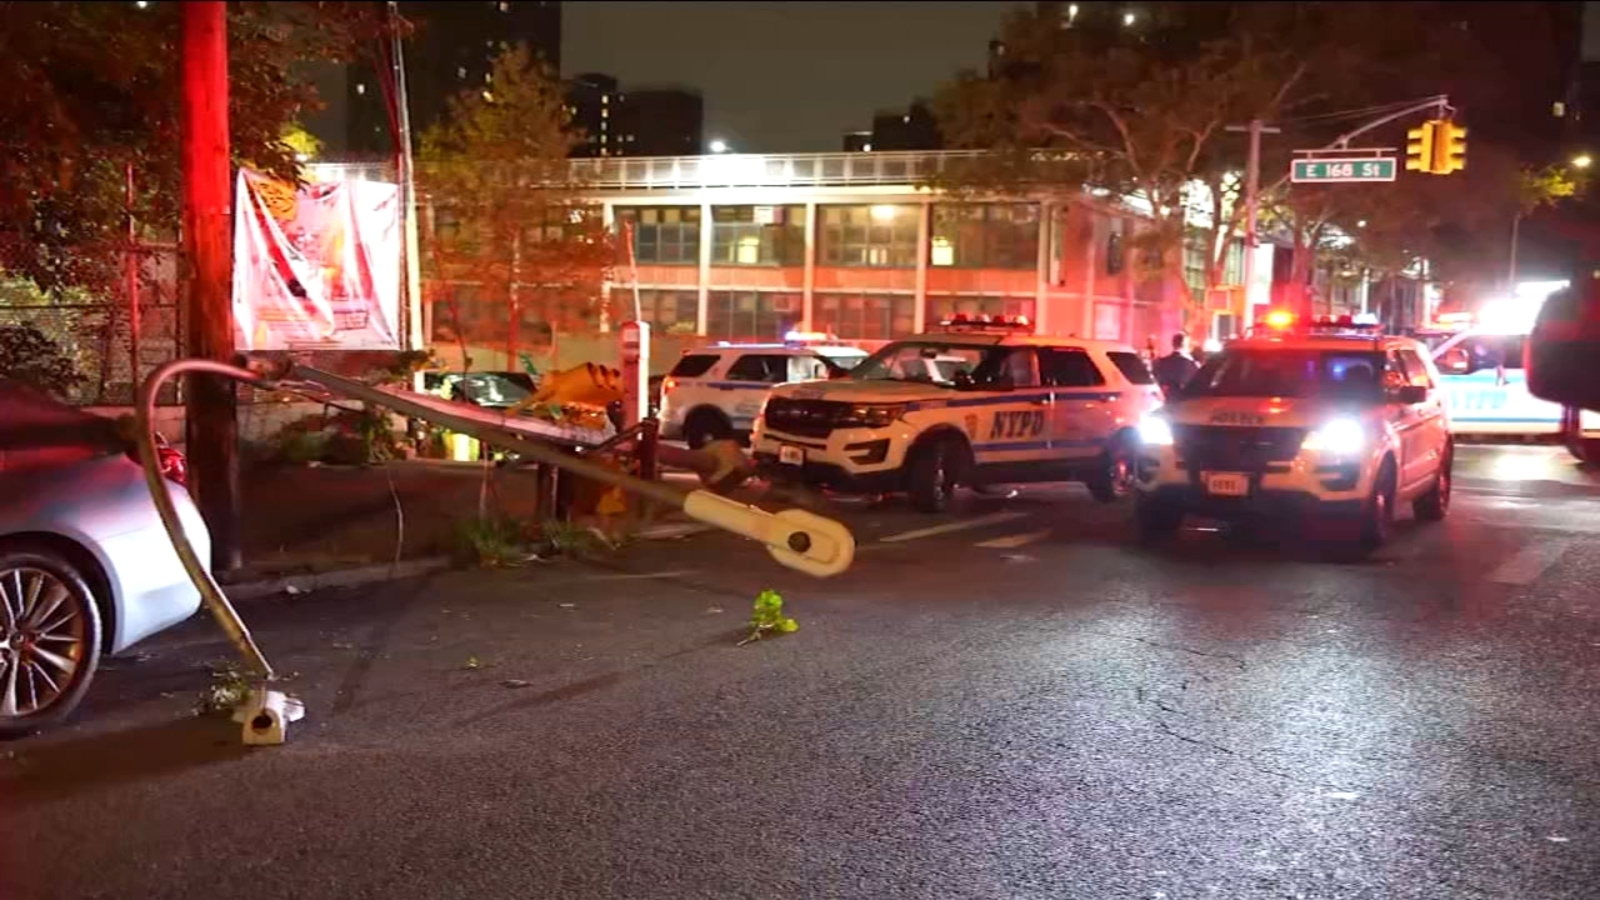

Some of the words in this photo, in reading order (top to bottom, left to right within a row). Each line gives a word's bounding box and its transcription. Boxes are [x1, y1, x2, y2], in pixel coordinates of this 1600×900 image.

[1306, 163, 1317, 177] E
[1362, 162, 1380, 176] St
[990, 410, 1044, 439] NYPD
